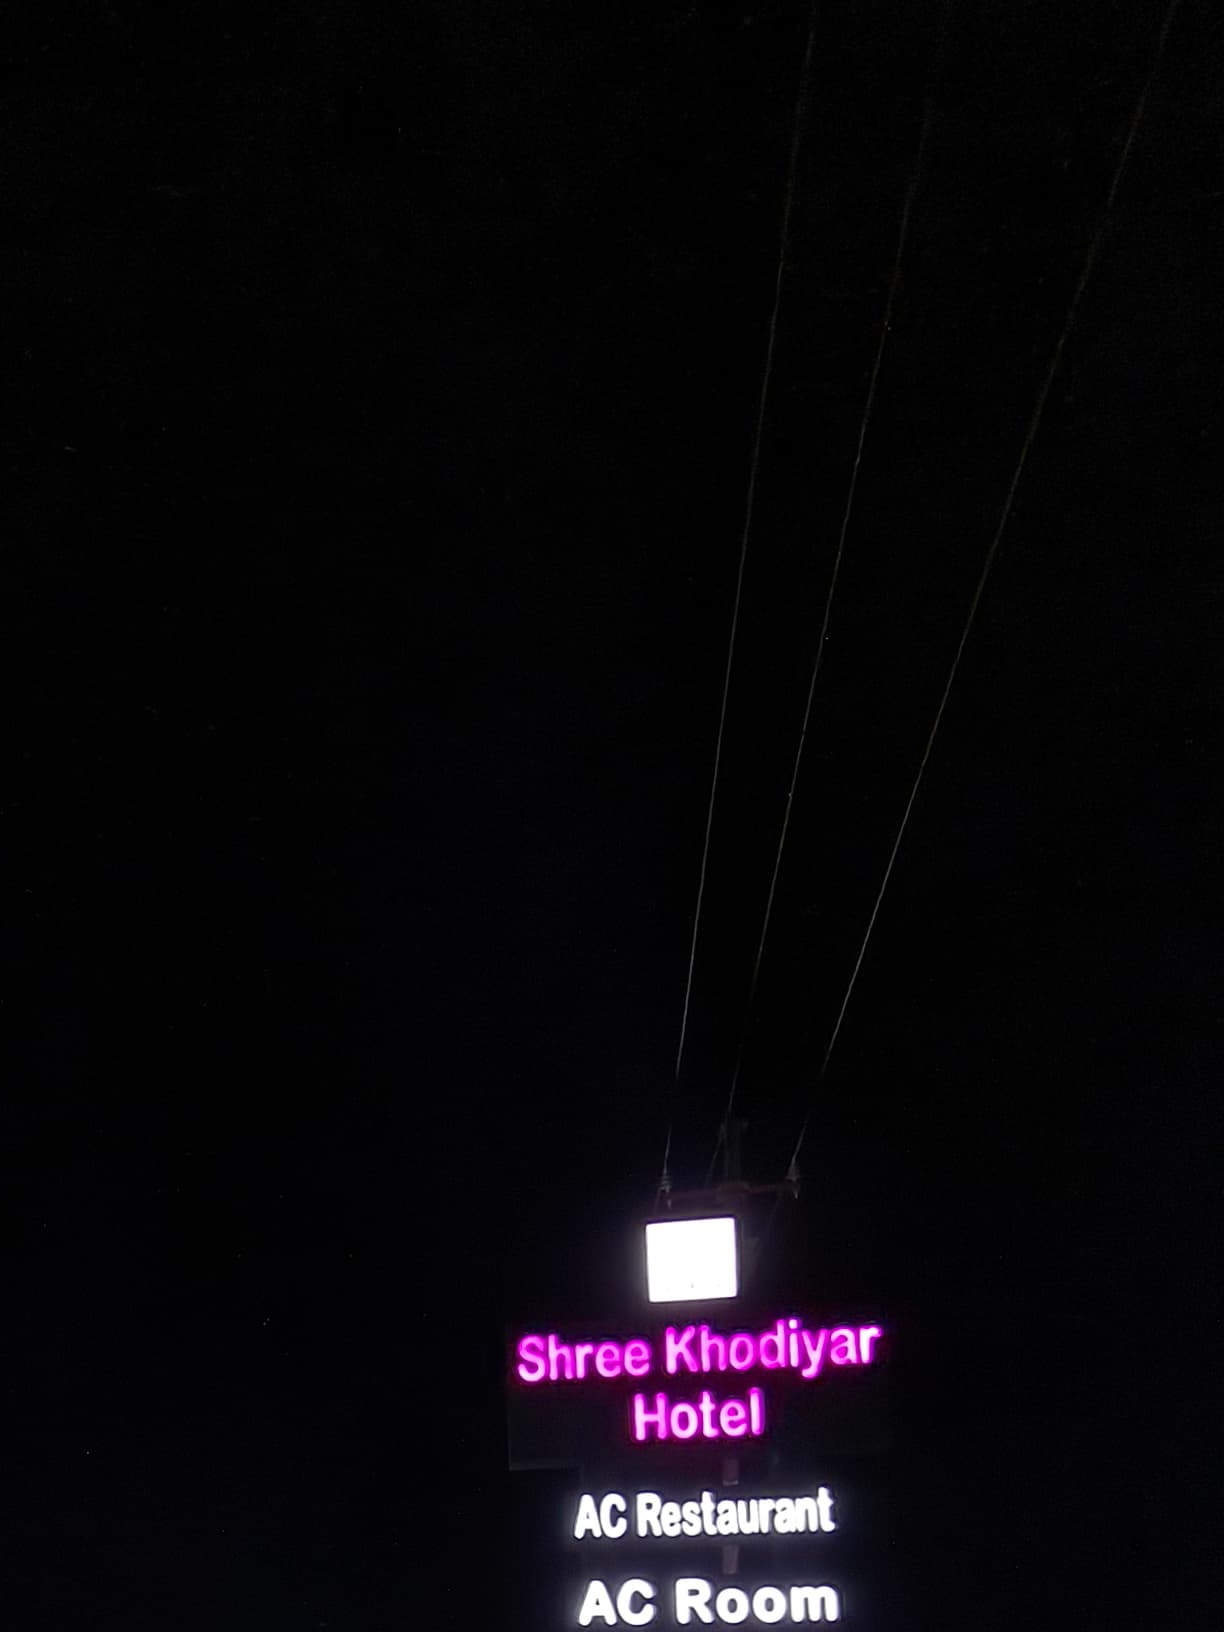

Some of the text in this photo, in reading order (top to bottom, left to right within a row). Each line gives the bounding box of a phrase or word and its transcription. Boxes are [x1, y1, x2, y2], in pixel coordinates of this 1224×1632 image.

[517, 1318, 882, 1382] Shree Khodiyar
[633, 1387, 763, 1441] Hotel
[574, 1487, 836, 1539] AC Restaurant
[578, 1578, 839, 1626] AC Room
